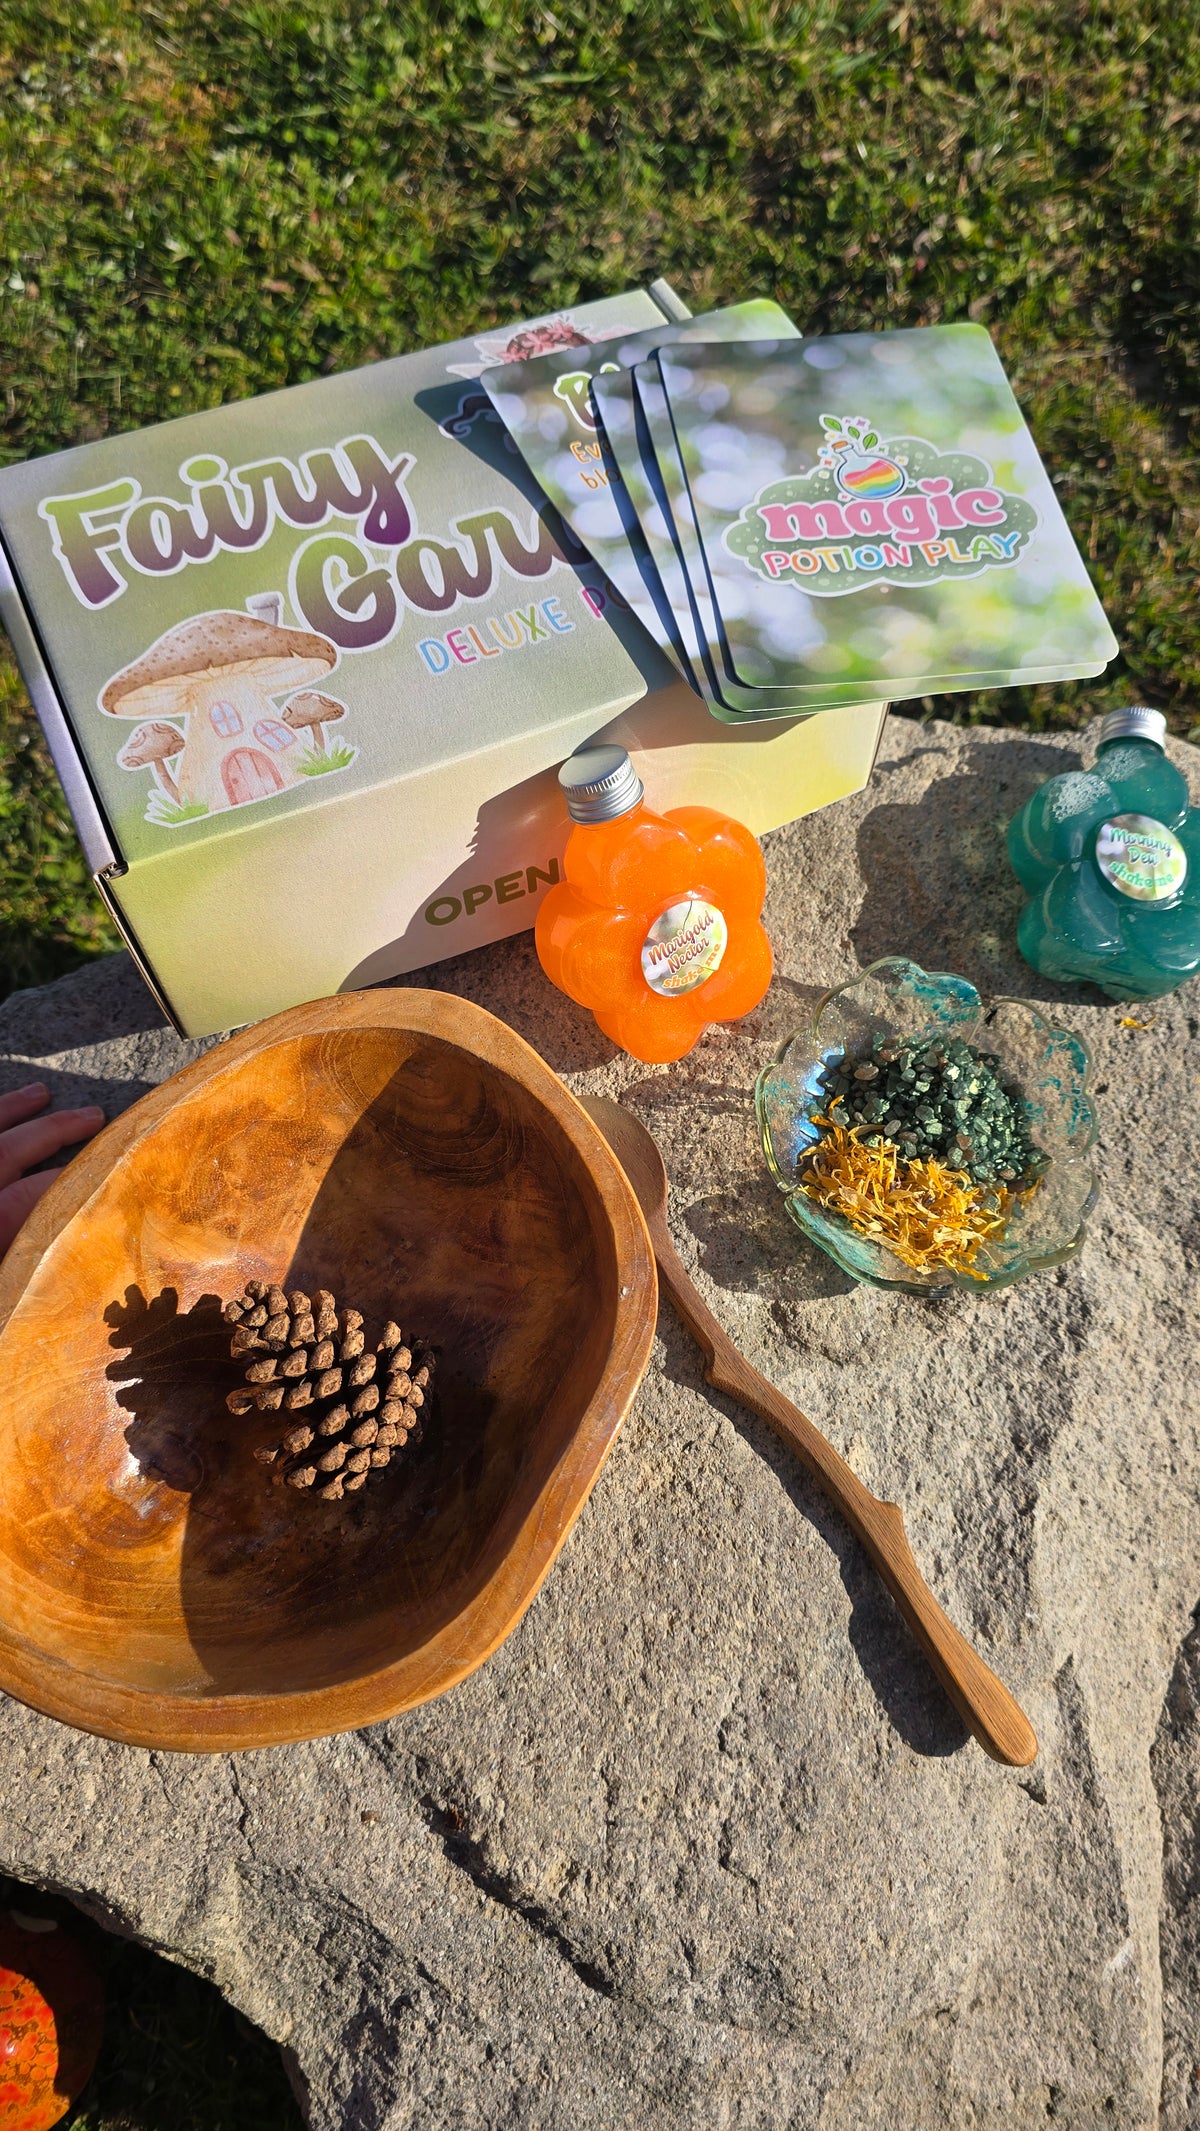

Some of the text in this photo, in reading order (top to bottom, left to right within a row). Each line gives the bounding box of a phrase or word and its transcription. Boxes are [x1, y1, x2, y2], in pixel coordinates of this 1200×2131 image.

[42, 436, 415, 606] Fairy
[760, 478, 1005, 543] magic
[763, 532, 1020, 577] POTION PLAY
[419, 597, 573, 674] DELUXE
[1109, 828, 1172, 858] Morning
[1128, 847, 1160, 866] Dew
[424, 857, 560, 926] OPEN
[648, 910, 714, 966] Marigold
[667, 937, 710, 974] Nectar
[663, 943, 721, 988] shake me
